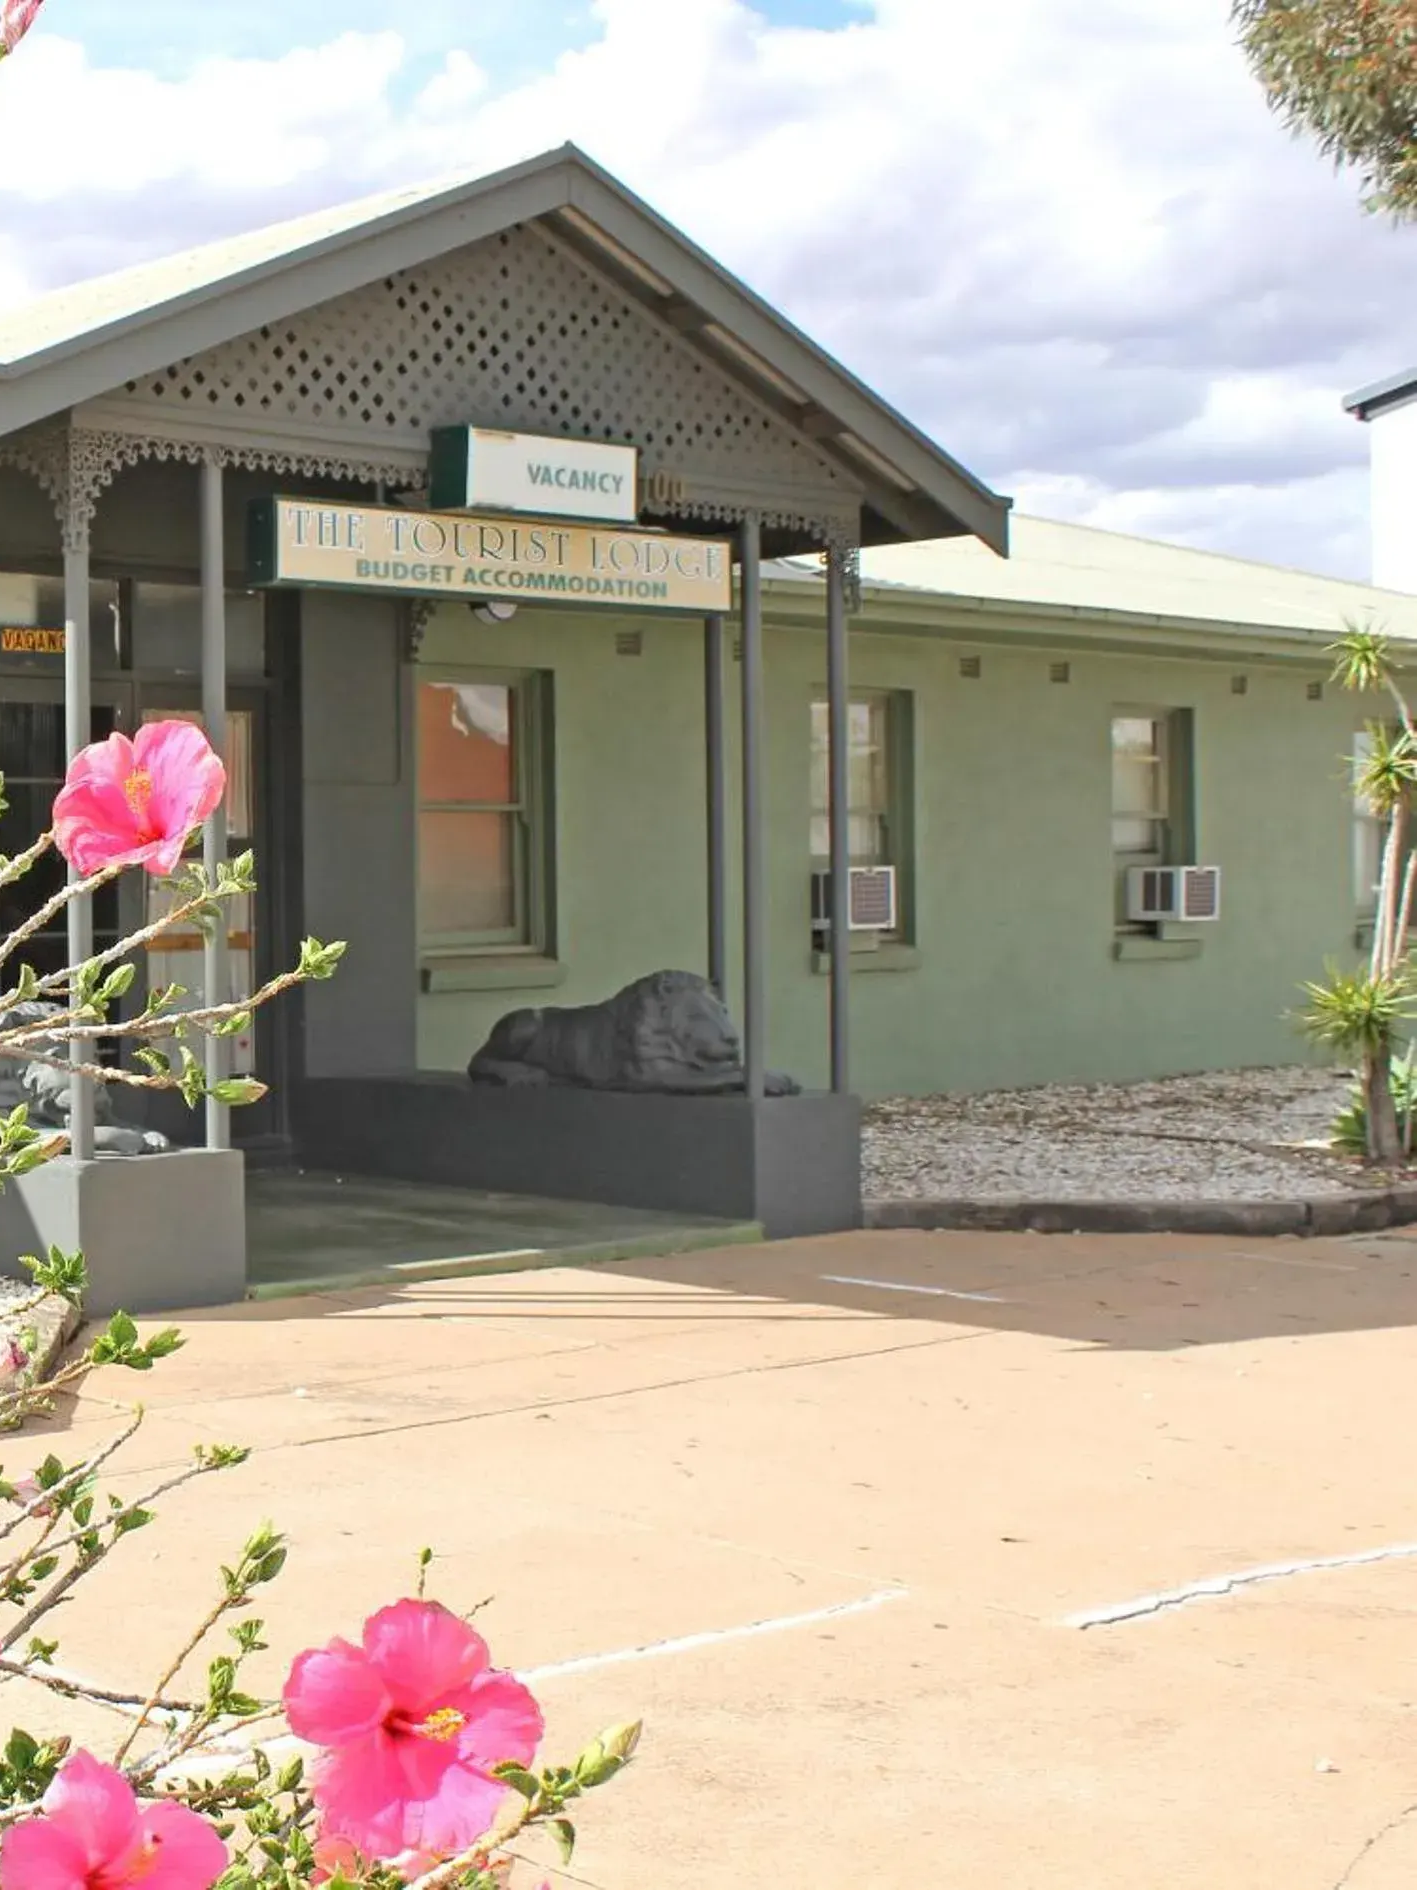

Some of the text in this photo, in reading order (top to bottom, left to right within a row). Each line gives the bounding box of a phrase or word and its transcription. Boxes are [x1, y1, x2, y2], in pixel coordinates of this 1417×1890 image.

[527, 463, 624, 495] VACANCY
[288, 507, 722, 583] THE TOURIST LODGE
[356, 558, 668, 599] BUDGET ACCOMMODATION
[2, 628, 65, 651] VACAN
